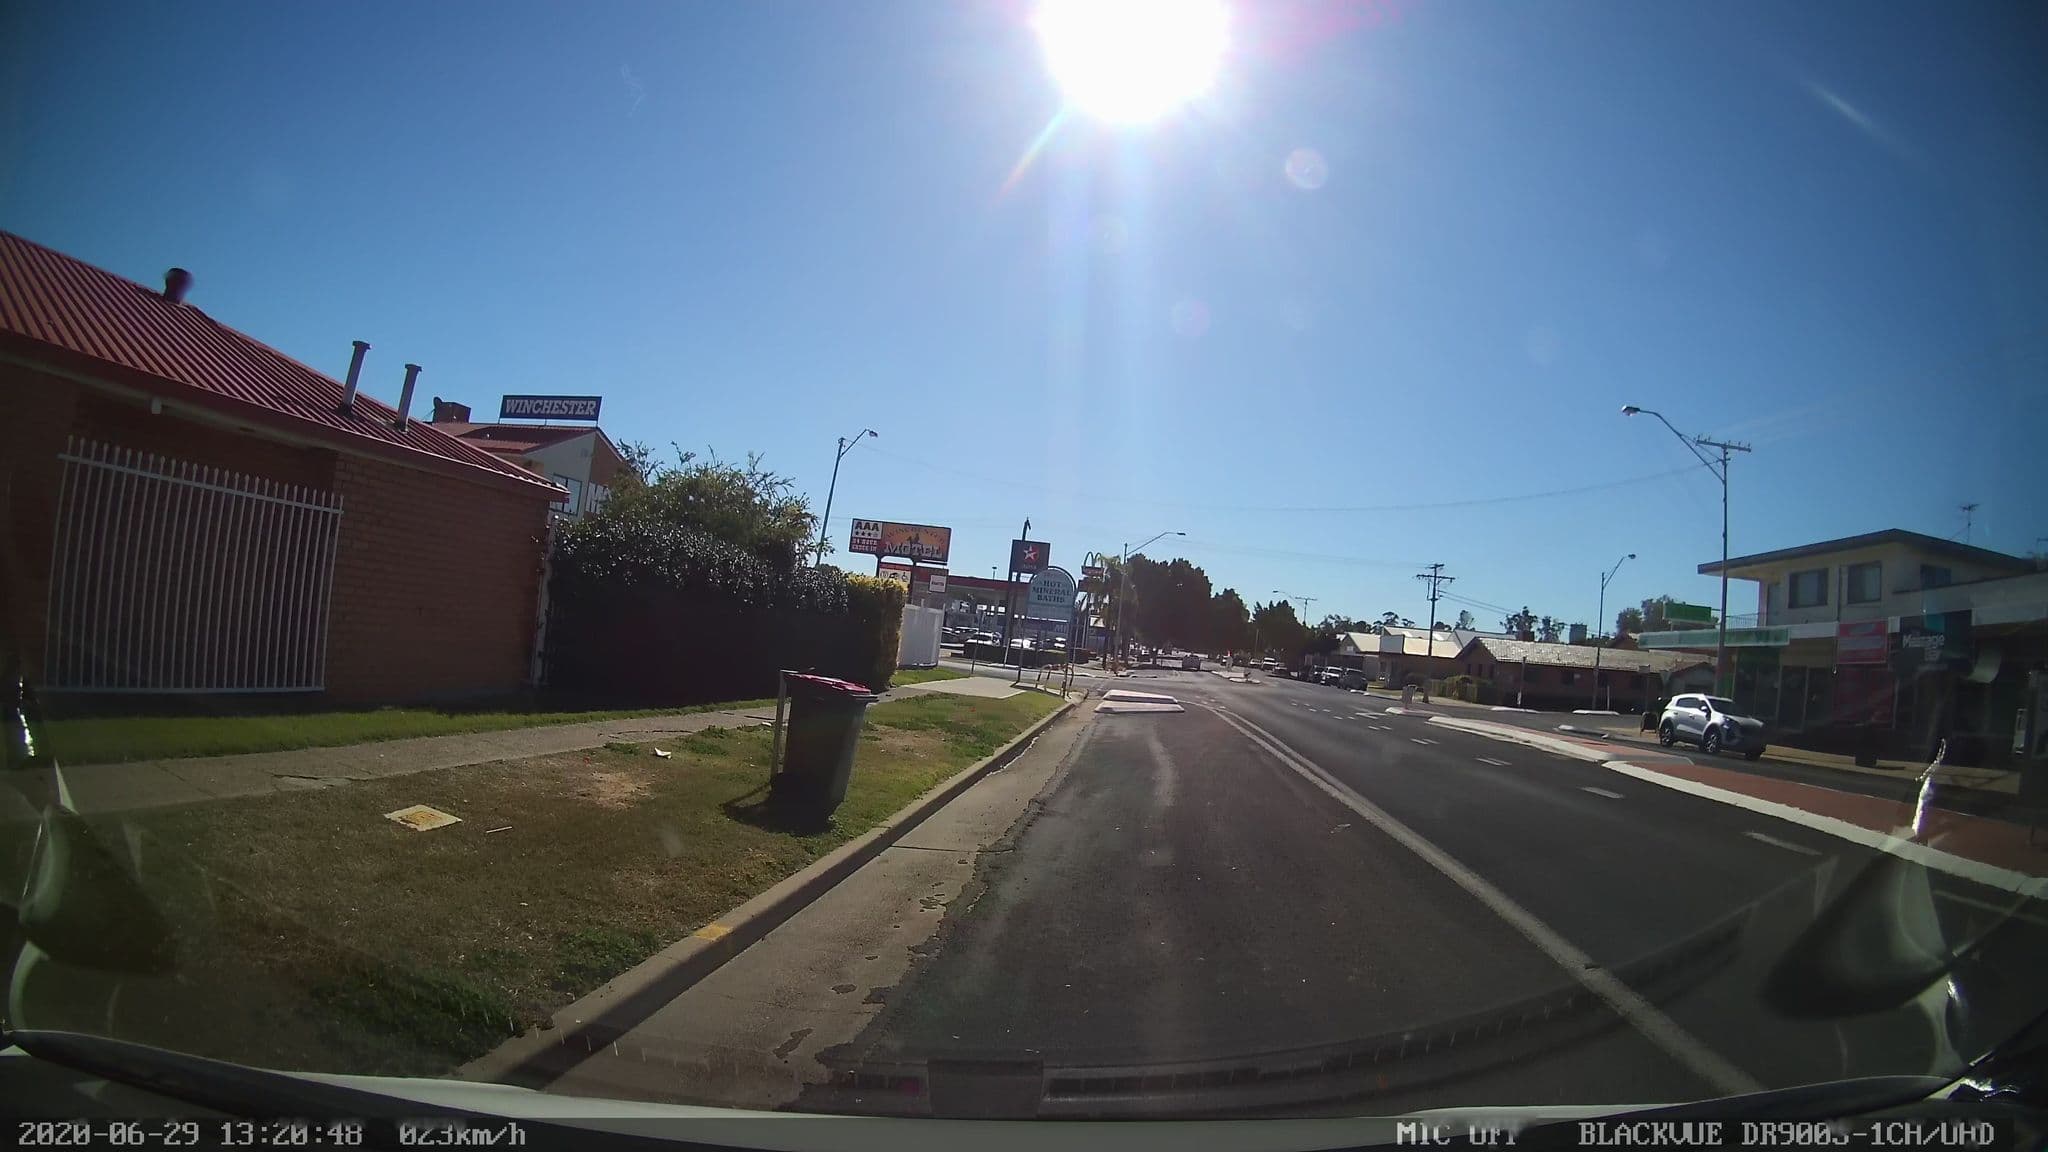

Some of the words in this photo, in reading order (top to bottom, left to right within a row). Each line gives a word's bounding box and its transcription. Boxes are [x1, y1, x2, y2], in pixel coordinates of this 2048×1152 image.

[505, 398, 597, 416] WINCHESTER
[855, 521, 879, 532] AAA
[884, 541, 943, 558] MOTEL
[1043, 580, 1061, 588] HOT
[1032, 586, 1072, 597] MINERAL
[1037, 594, 1065, 604] BATHS
[1902, 633, 1945, 650] Mage
